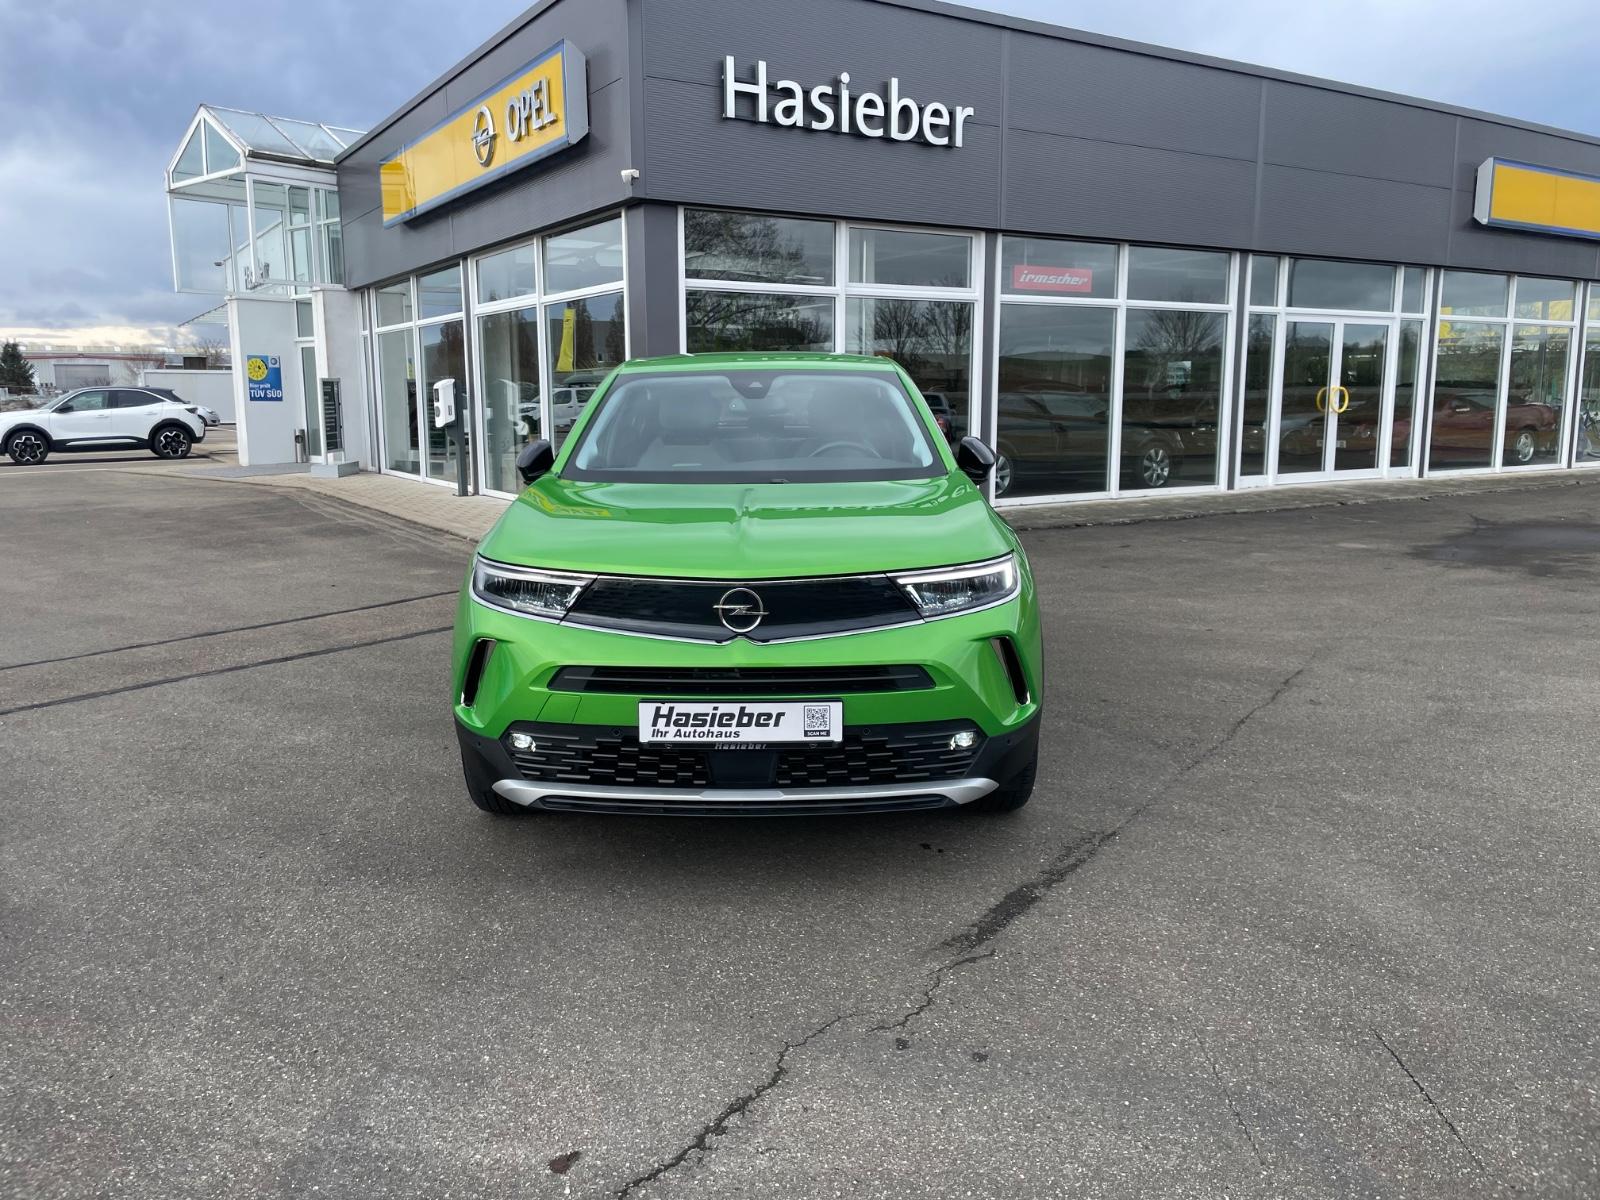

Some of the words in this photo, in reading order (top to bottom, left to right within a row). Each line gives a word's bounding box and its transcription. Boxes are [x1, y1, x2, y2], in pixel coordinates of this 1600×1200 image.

[506, 77, 557, 142] OPEL
[723, 55, 974, 148] Hasieber
[1019, 270, 1088, 285] irmscher
[250, 388, 265, 398] TÜV
[266, 388, 282, 398] SÜD
[651, 705, 786, 728] Hasieber
[651, 728, 669, 738] Ihr
[674, 728, 741, 738] Autohaus
